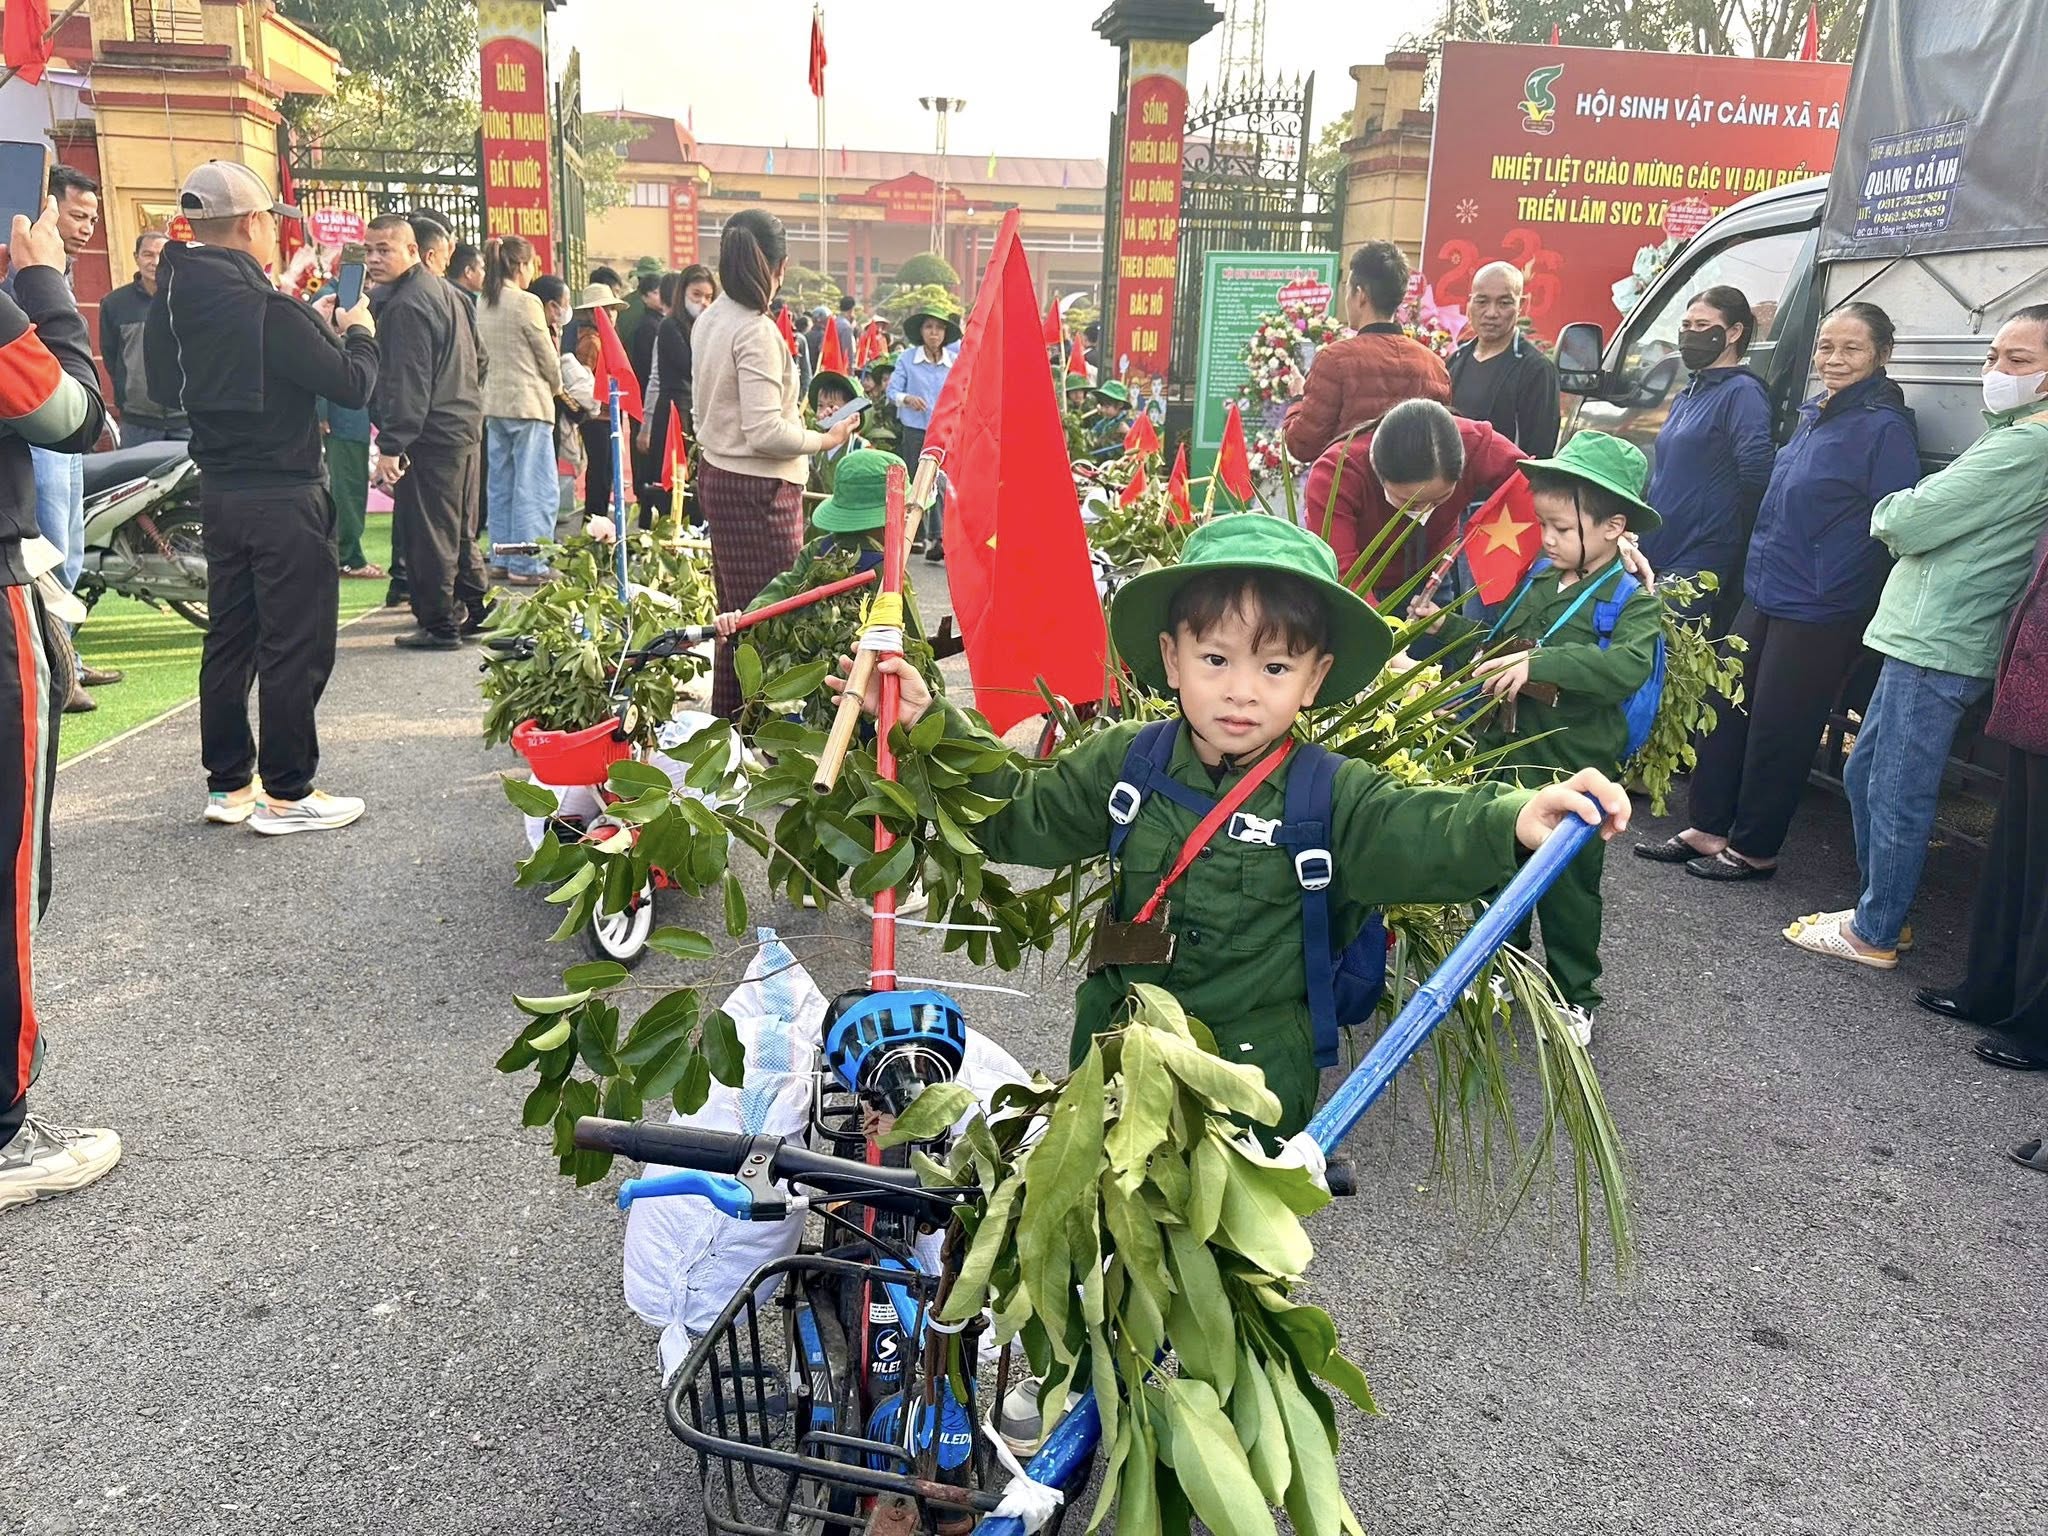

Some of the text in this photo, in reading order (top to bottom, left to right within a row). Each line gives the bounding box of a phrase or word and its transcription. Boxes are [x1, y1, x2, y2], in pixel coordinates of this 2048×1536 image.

[496, 54, 527, 92] ĐẢNG
[482, 106, 545, 147] VỮNG MẠNH
[1142, 93, 1169, 125] SỐNG
[1575, 88, 1616, 123] HỘI
[1619, 95, 1669, 120] SINH
[1674, 93, 1714, 128] VẬT
[1717, 94, 1779, 126] CẢNH
[1781, 100, 1812, 128] XÃ
[1129, 134, 1178, 164] CHIẾN ĐẤU
[489, 151, 541, 188] ĐẤT NƯỚC
[1491, 152, 1542, 186] NHIỆT
[1545, 154, 1581, 187] LIỆT
[1584, 156, 1629, 185] CHÀO
[1632, 158, 1684, 188] MỪNG
[1687, 161, 1721, 190] CÁC
[1725, 167, 1741, 195] VỊ
[1864, 154, 1959, 200] QUANG CẢNH
[1129, 175, 1174, 207] LAO ĐỘNG
[1518, 188, 1567, 222] TRIỂN
[1569, 195, 1607, 224] LÃM
[1609, 201, 1643, 226] SVC
[488, 197, 547, 236] PHÁT TRIỂN
[1124, 213, 1176, 246] VÀ HỌC TẬP
[1121, 254, 1176, 278] THEO GƯƠNG
[1129, 289, 1149, 315] BÁC
[1131, 326, 1158, 357] VĨ ĐẠI
